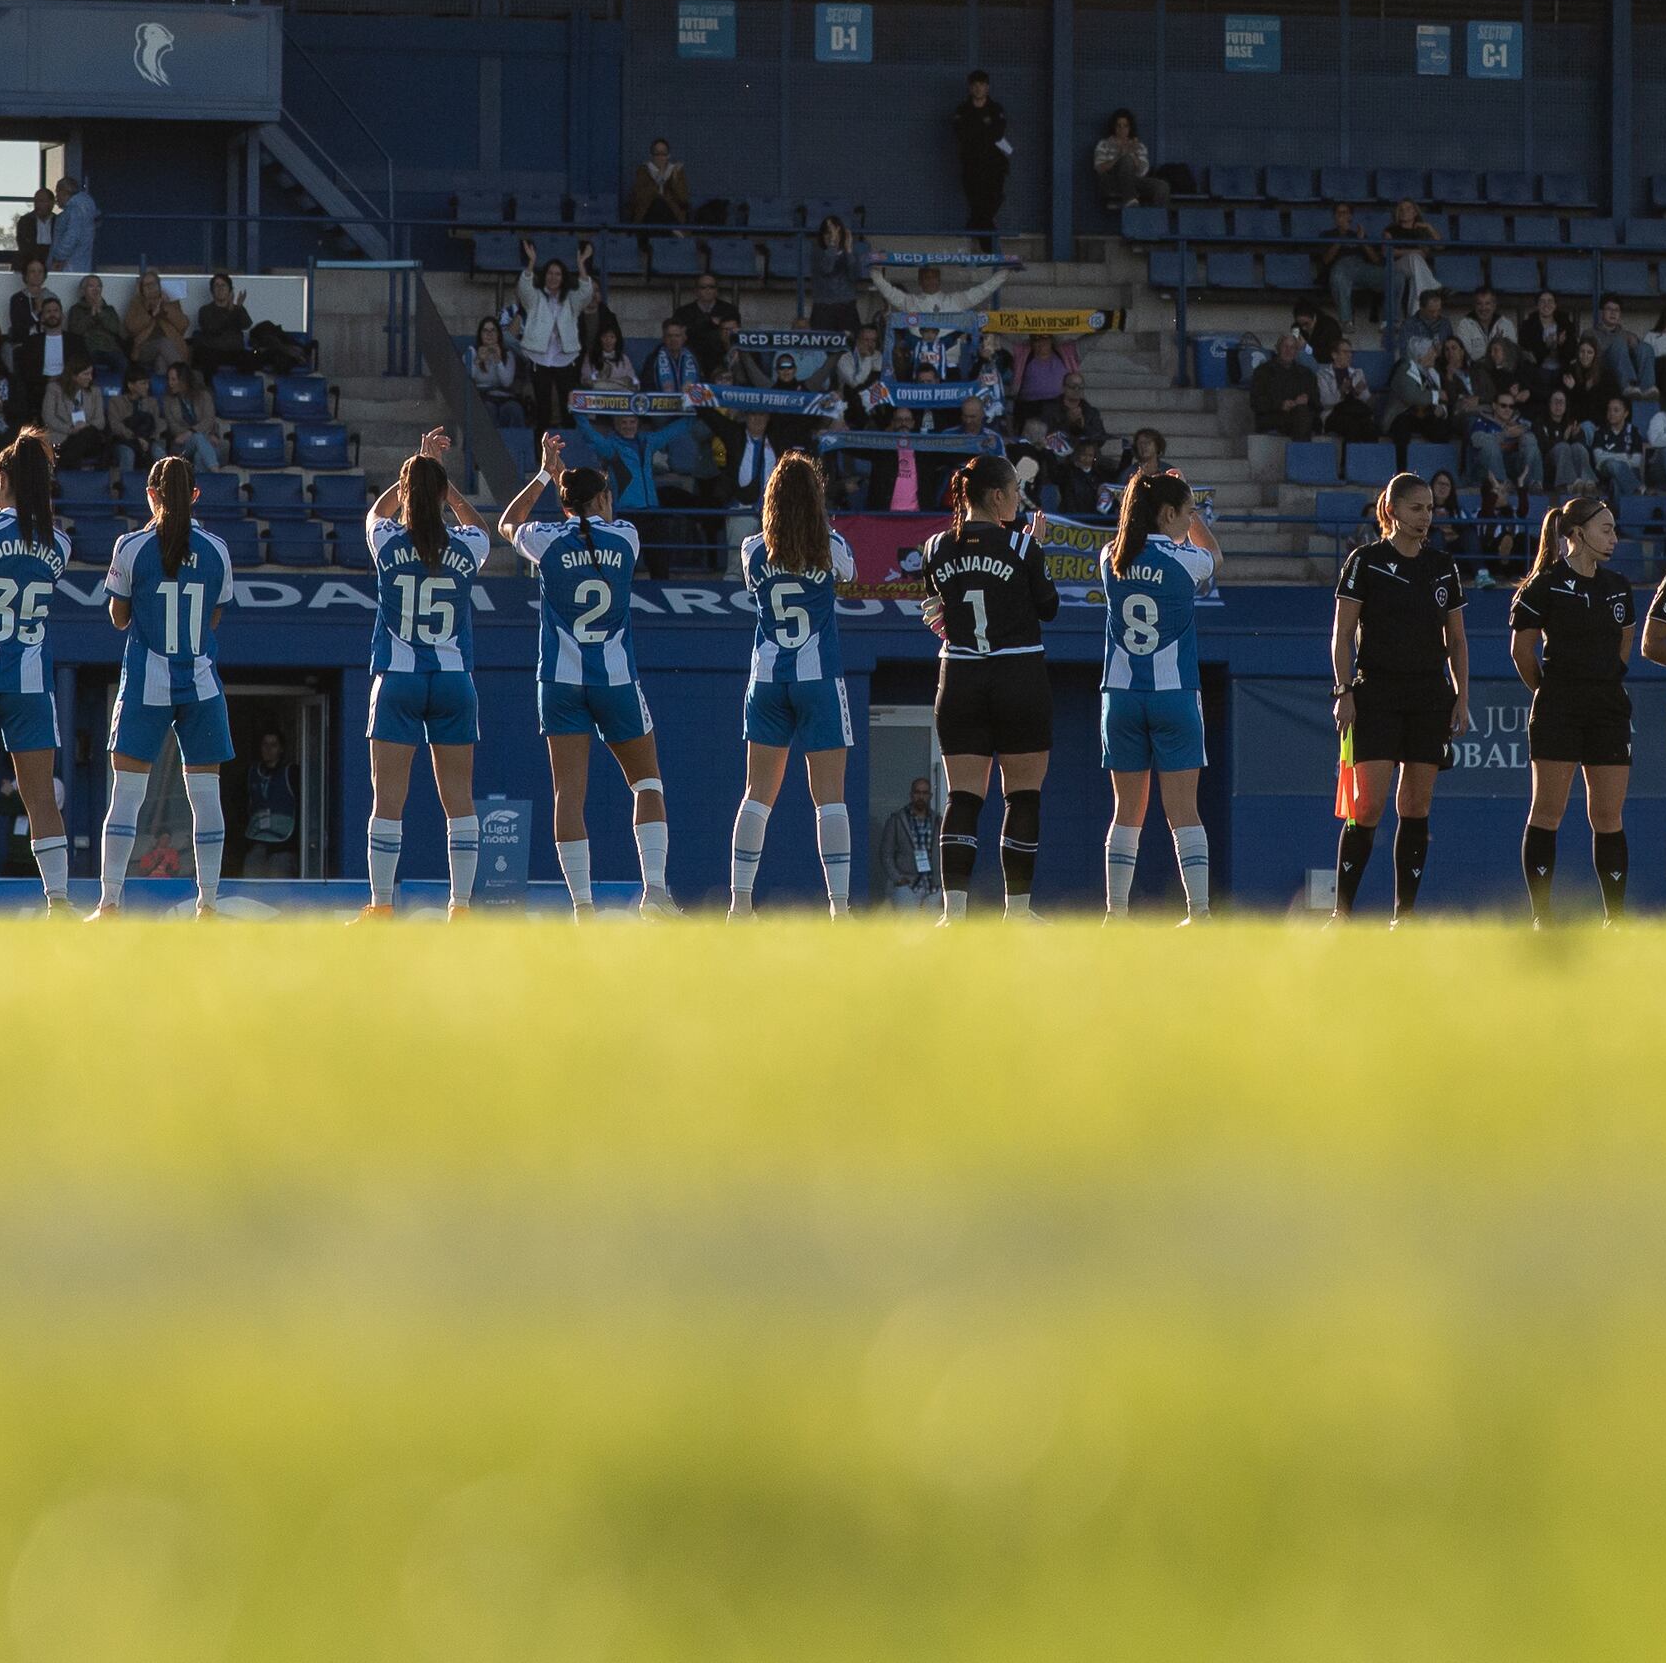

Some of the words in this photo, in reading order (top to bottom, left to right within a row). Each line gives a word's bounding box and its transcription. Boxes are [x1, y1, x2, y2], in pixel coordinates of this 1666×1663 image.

[826, 7, 862, 23] SECTOR
[678, 31, 707, 44] BASE
[831, 26, 857, 51] D-1
[1226, 32, 1265, 45] FUTBOL
[1478, 25, 1513, 40] SECTOR
[1226, 45, 1253, 58] BASE
[1482, 43, 1508, 68] C-1
[893, 252, 923, 263] RCD
[927, 253, 999, 263] ESPANYOL
[738, 333, 768, 345] RCD
[721, 390, 760, 404] COYOTES
[896, 388, 933, 401] COYOTES
[380, 556, 392, 572] L.
[393, 545, 475, 579] MAÍNEZ
[561, 548, 623, 570] SIMONA
[935, 556, 1014, 583] SALVADOR
[750, 573, 764, 587] L.
[760, 562, 827, 585] VALJO
[156, 581, 205, 656] 11
[393, 574, 457, 645] 15
[572, 579, 613, 644] 2
[770, 582, 811, 649] 5
[963, 590, 991, 653] 1
[1121, 593, 1160, 656] 8
[482, 836, 519, 844] moeve
[487, 824, 509, 835] Liga
[510, 824, 517, 833] F
